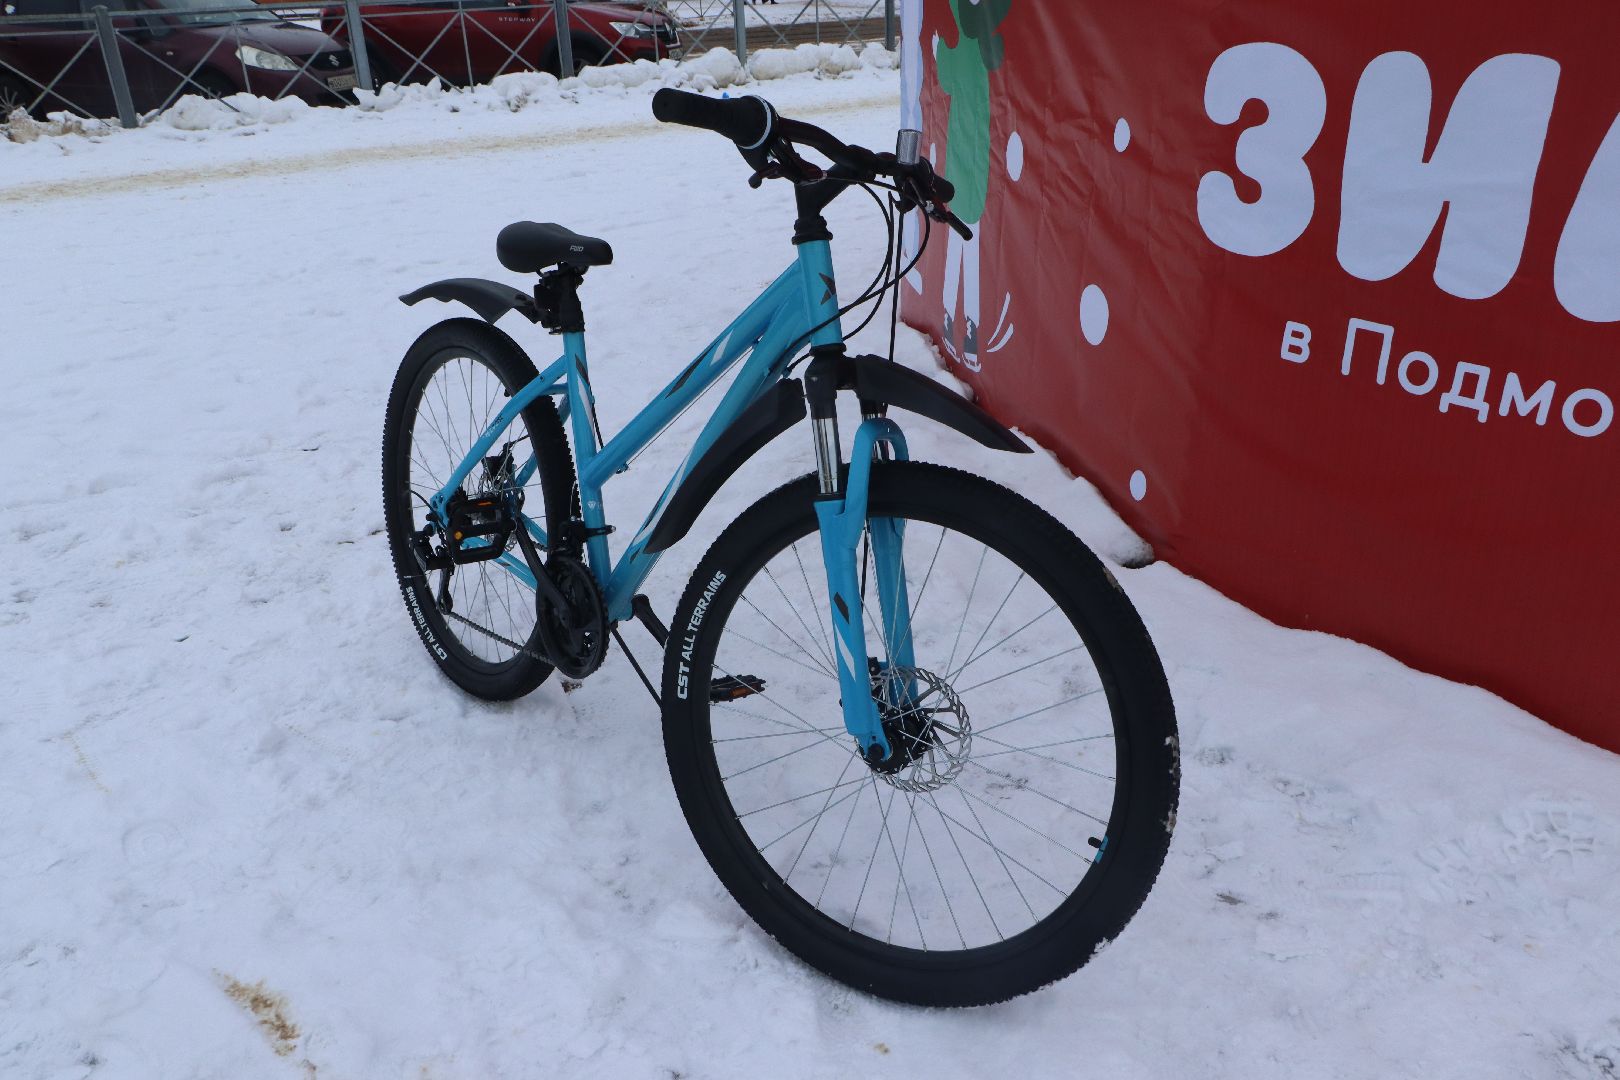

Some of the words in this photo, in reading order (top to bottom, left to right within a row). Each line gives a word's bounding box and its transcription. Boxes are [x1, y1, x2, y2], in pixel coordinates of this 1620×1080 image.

[1197, 42, 1620, 323] ЗИ
[1281, 320, 1312, 364] в
[1341, 317, 1614, 438] Подмо
[405, 586, 428, 630] TERRAINS
[687, 570, 727, 633] TERRAINS
[424, 627, 436, 644] ALL
[432, 642, 448, 660] CST
[681, 634, 696, 662] ALL
[677, 661, 690, 700] CST
